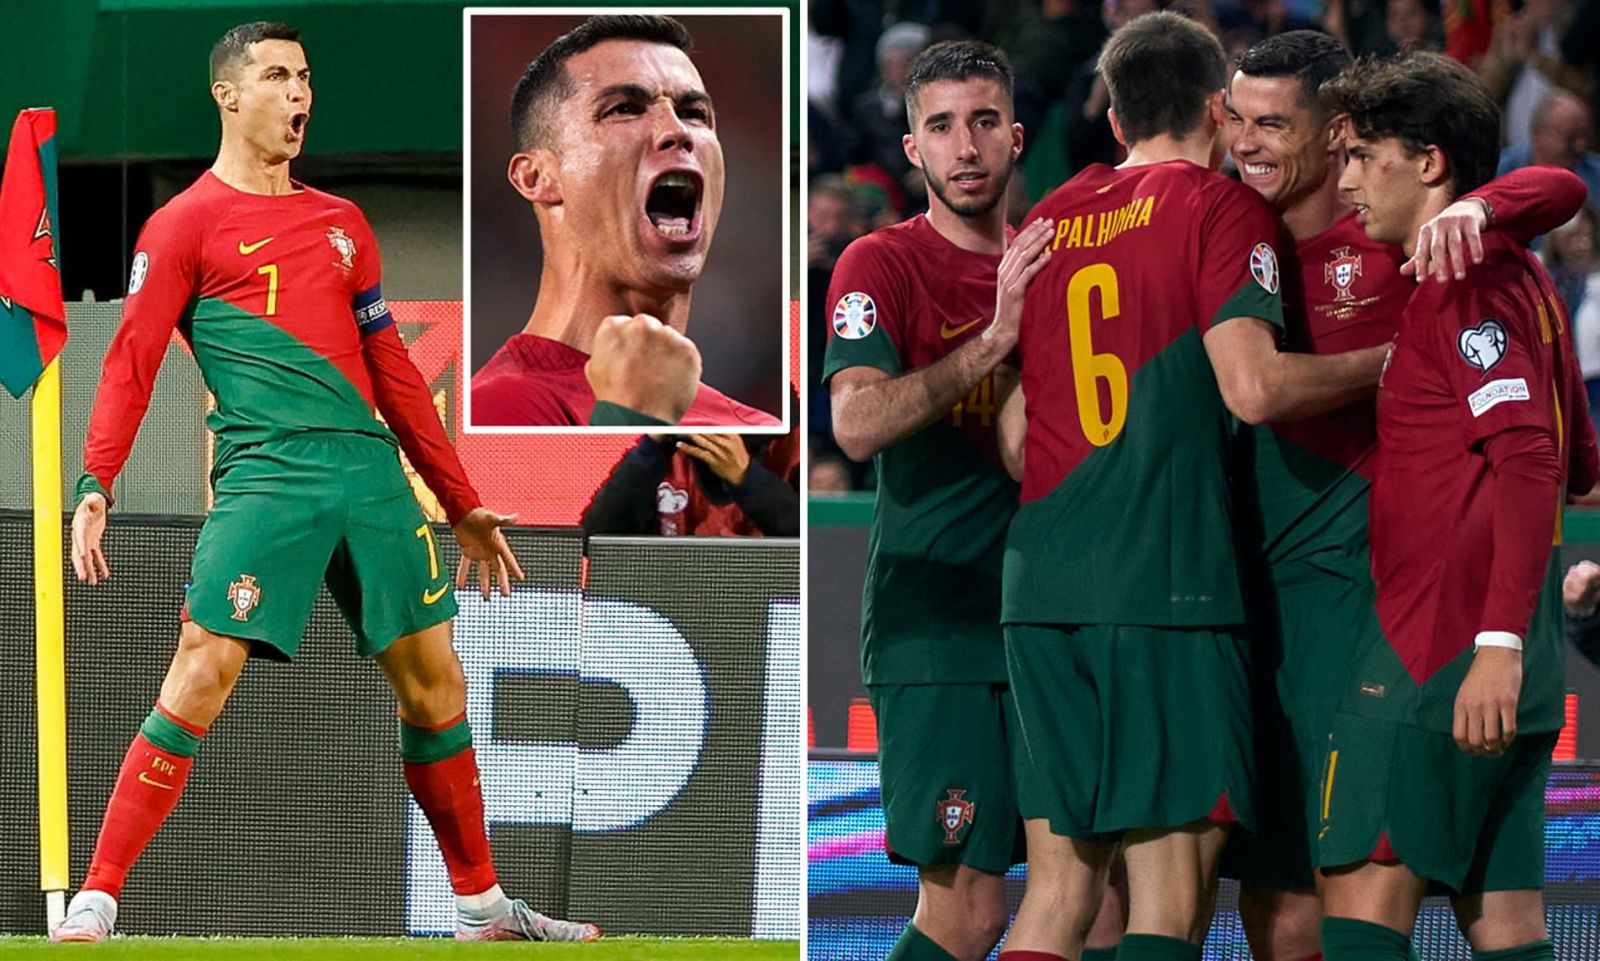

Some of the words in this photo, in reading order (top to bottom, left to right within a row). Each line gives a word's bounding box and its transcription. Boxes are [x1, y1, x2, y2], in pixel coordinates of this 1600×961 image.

[257, 264, 278, 315] 7
[1067, 263, 1128, 446] 6
[416, 524, 438, 579] 7
